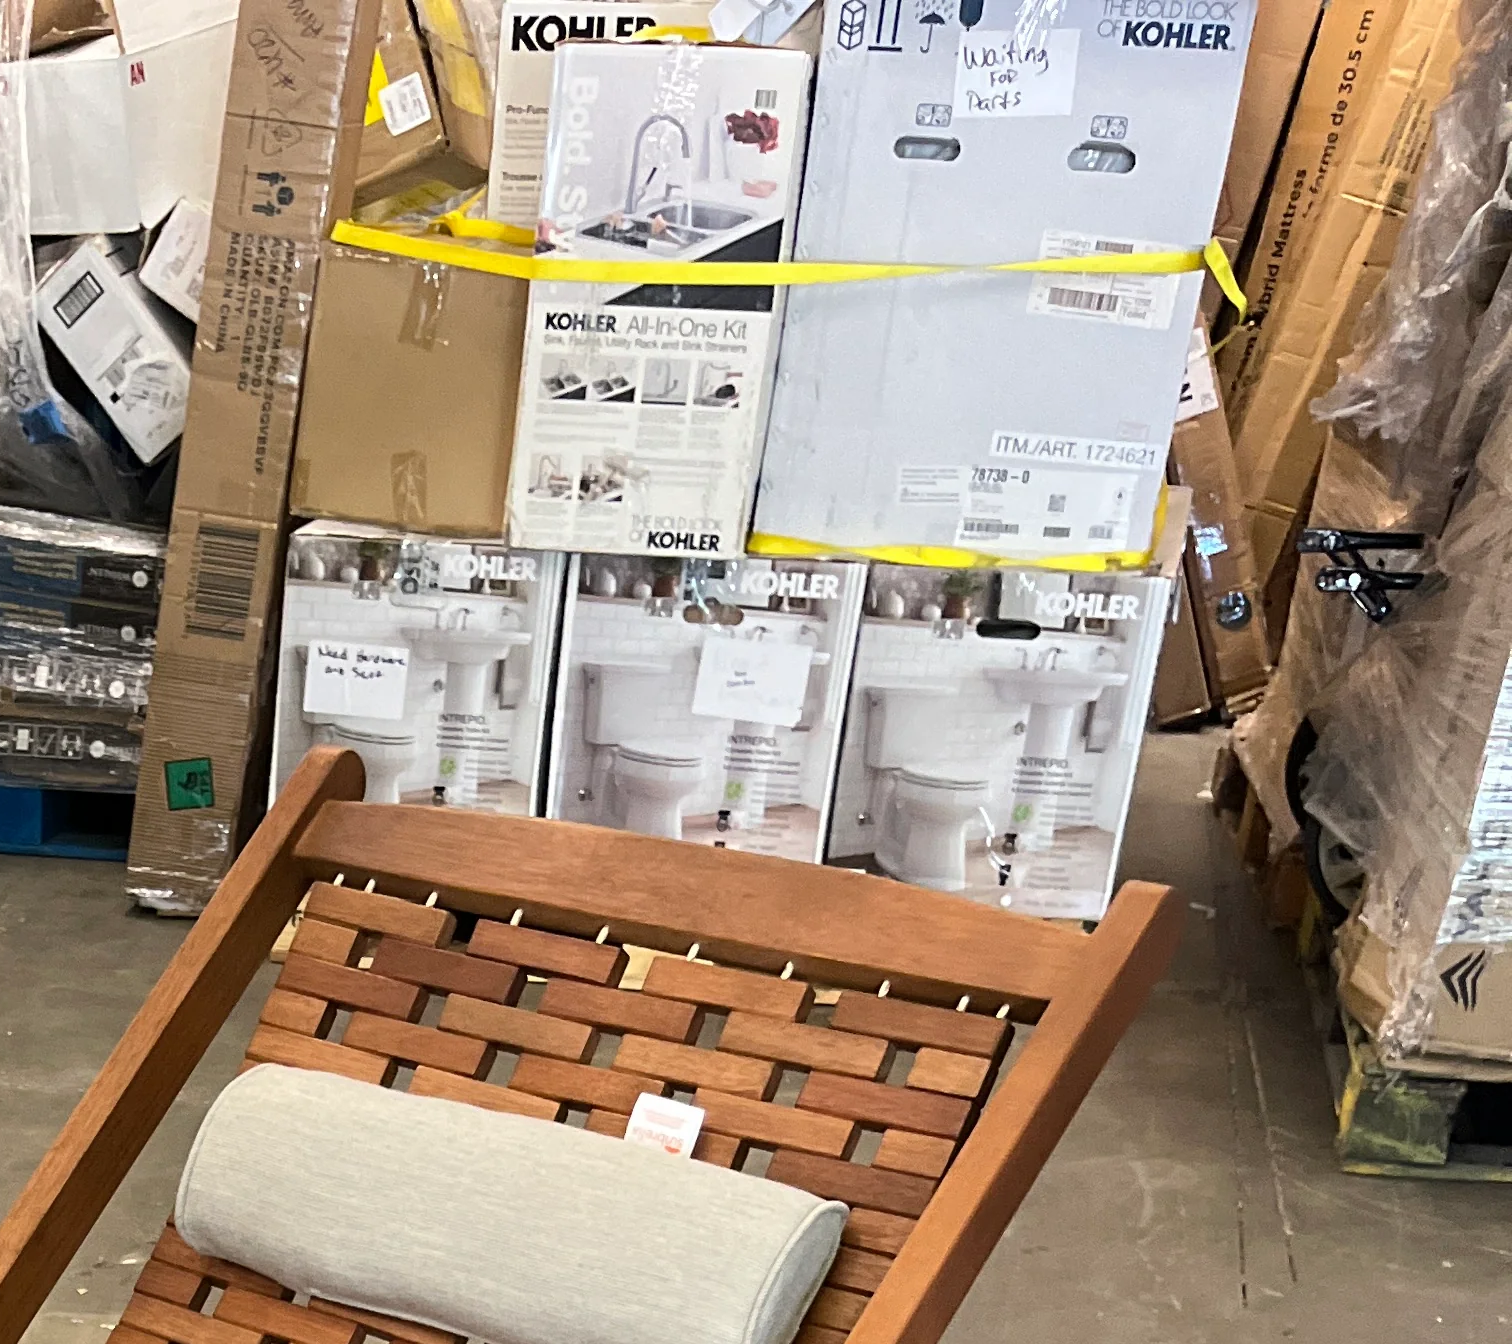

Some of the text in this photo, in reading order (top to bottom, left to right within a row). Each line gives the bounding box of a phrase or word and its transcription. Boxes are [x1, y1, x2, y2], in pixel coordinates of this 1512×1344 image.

[1102, 0, 1235, 21] THE BOLD LOOK
[1097, 18, 1231, 50] OF KOHLER
[1355, 8, 1375, 43] cm
[963, 42, 1049, 76] Waiting
[1273, 167, 1308, 253] Mattress
[225, 232, 242, 275] MADE
[215, 305, 231, 354] CHINA
[545, 311, 748, 340] KOHLER All-In-One Kit
[1086, 443, 1156, 466] 1724621
[647, 530, 720, 552] KOHLER
[443, 553, 536, 581] KOHLER
[738, 571, 840, 600] KOHLER
[1034, 592, 1140, 620] KOHLER
